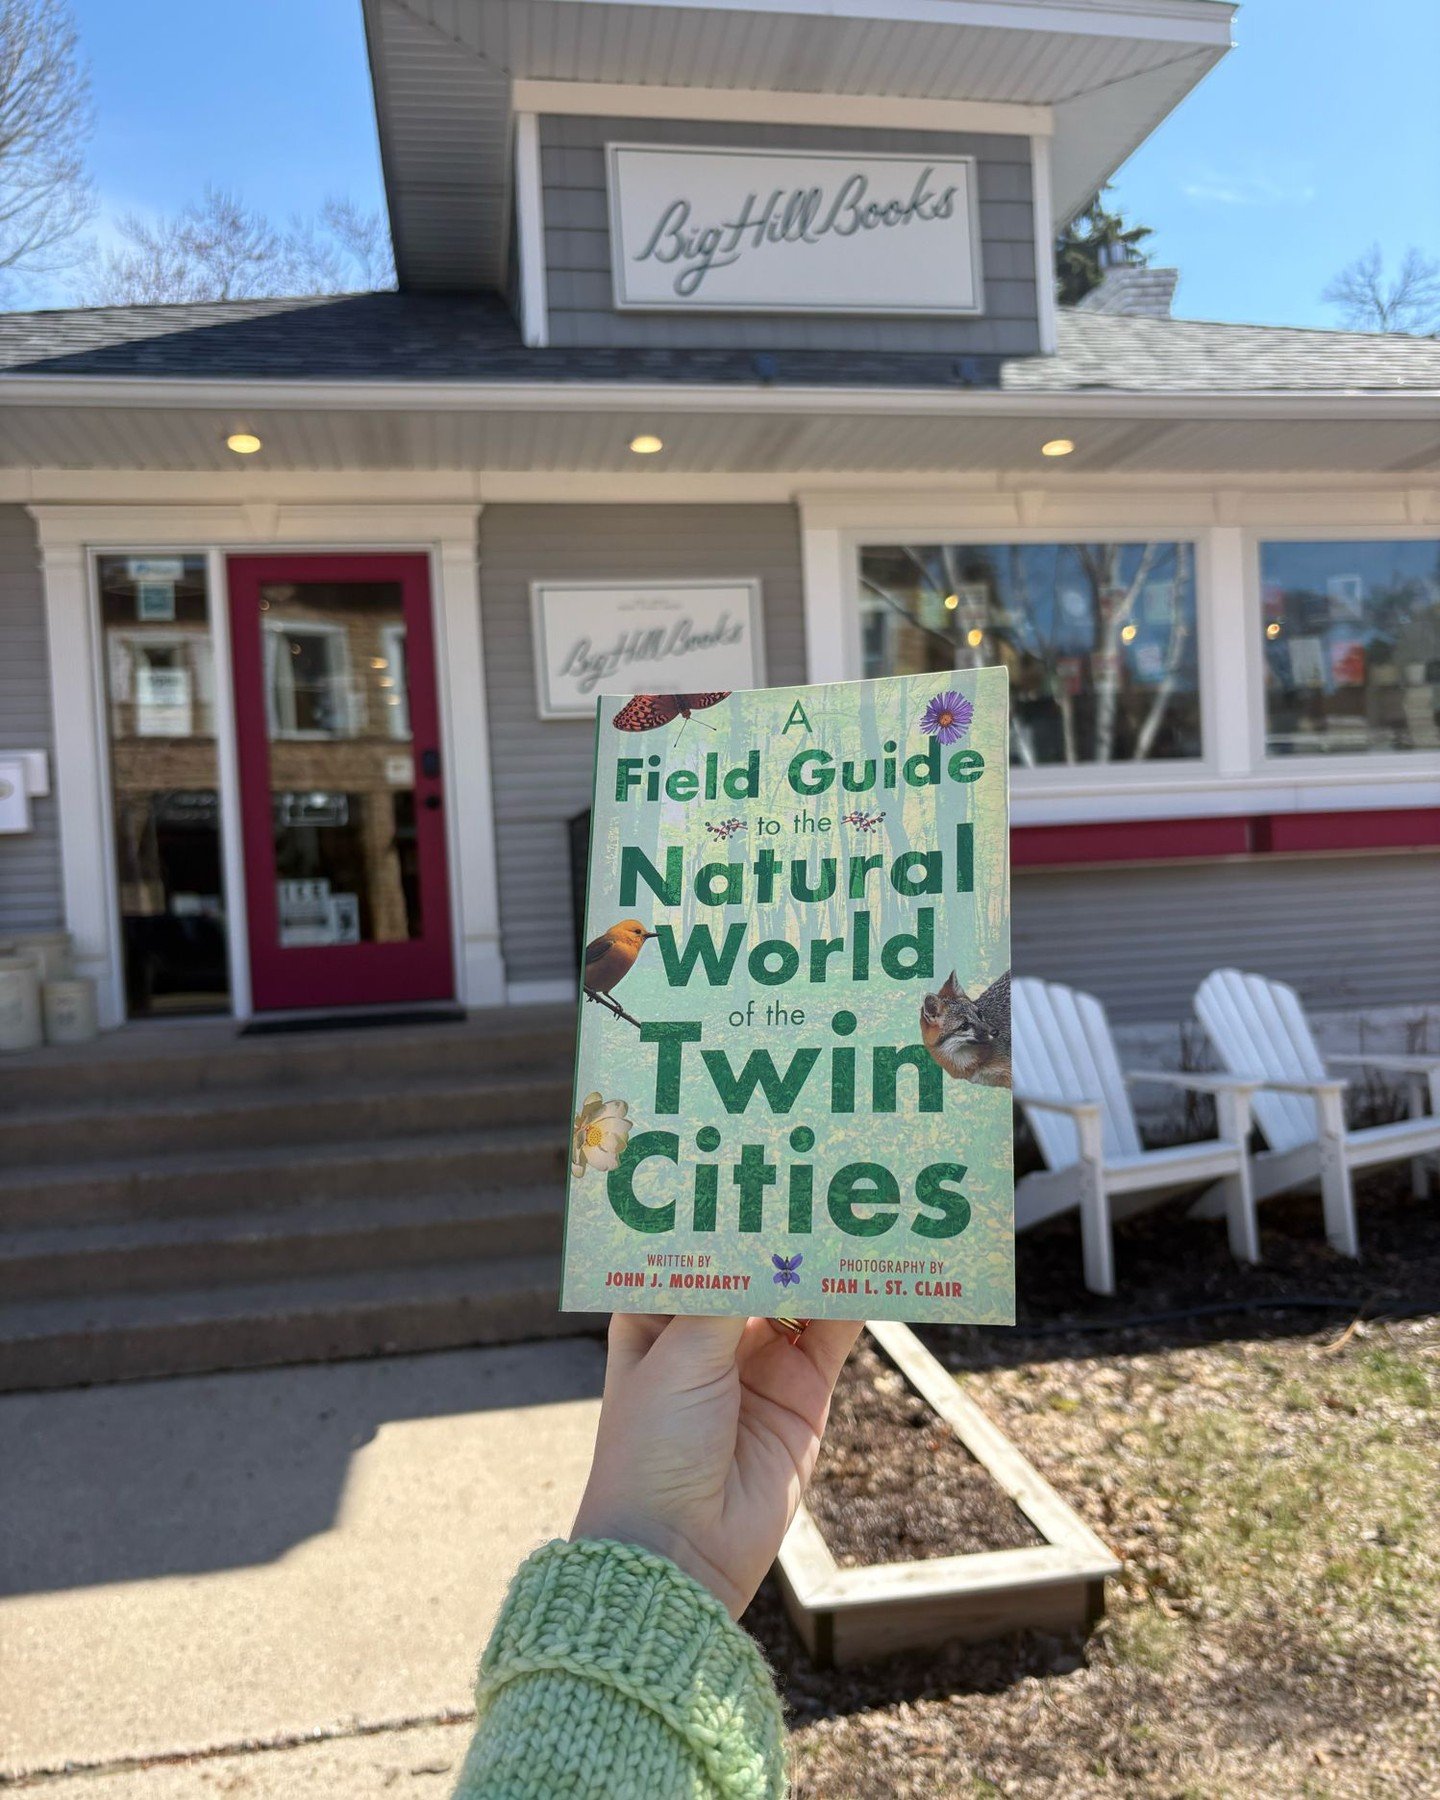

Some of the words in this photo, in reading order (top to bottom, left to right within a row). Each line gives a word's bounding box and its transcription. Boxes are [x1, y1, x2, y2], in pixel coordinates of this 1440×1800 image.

[633, 200, 741, 297] Big
[720, 188, 822, 254] Hill
[815, 166, 959, 237] Books
[558, 635, 620, 694] Big
[662, 609, 745, 657] Books
[781, 699, 813, 735] A
[615, 749, 761, 802] Field
[787, 736, 986, 796] Guide
[757, 816, 781, 836] to
[793, 808, 832, 834] the
[619, 823, 975, 907] Natural
[655, 907, 936, 988] World
[728, 1000, 754, 1027] of
[766, 999, 805, 1026] the
[639, 1010, 944, 1115] Twin
[606, 1125, 973, 1240] Cities
[605, 1271, 645, 1287] JOHN
[650, 1273, 663, 1288] J.
[669, 1273, 751, 1291] MORIARTY
[647, 1254, 694, 1268] WRITTEN
[697, 1255, 711, 1268] BY
[839, 1258, 926, 1274] PHOTOGRAPHY
[930, 1261, 944, 1275] BY
[821, 1278, 858, 1295] SIAH
[864, 1279, 879, 1295] L.
[885, 1280, 908, 1296] ST.
[914, 1281, 963, 1298] CLAIR
